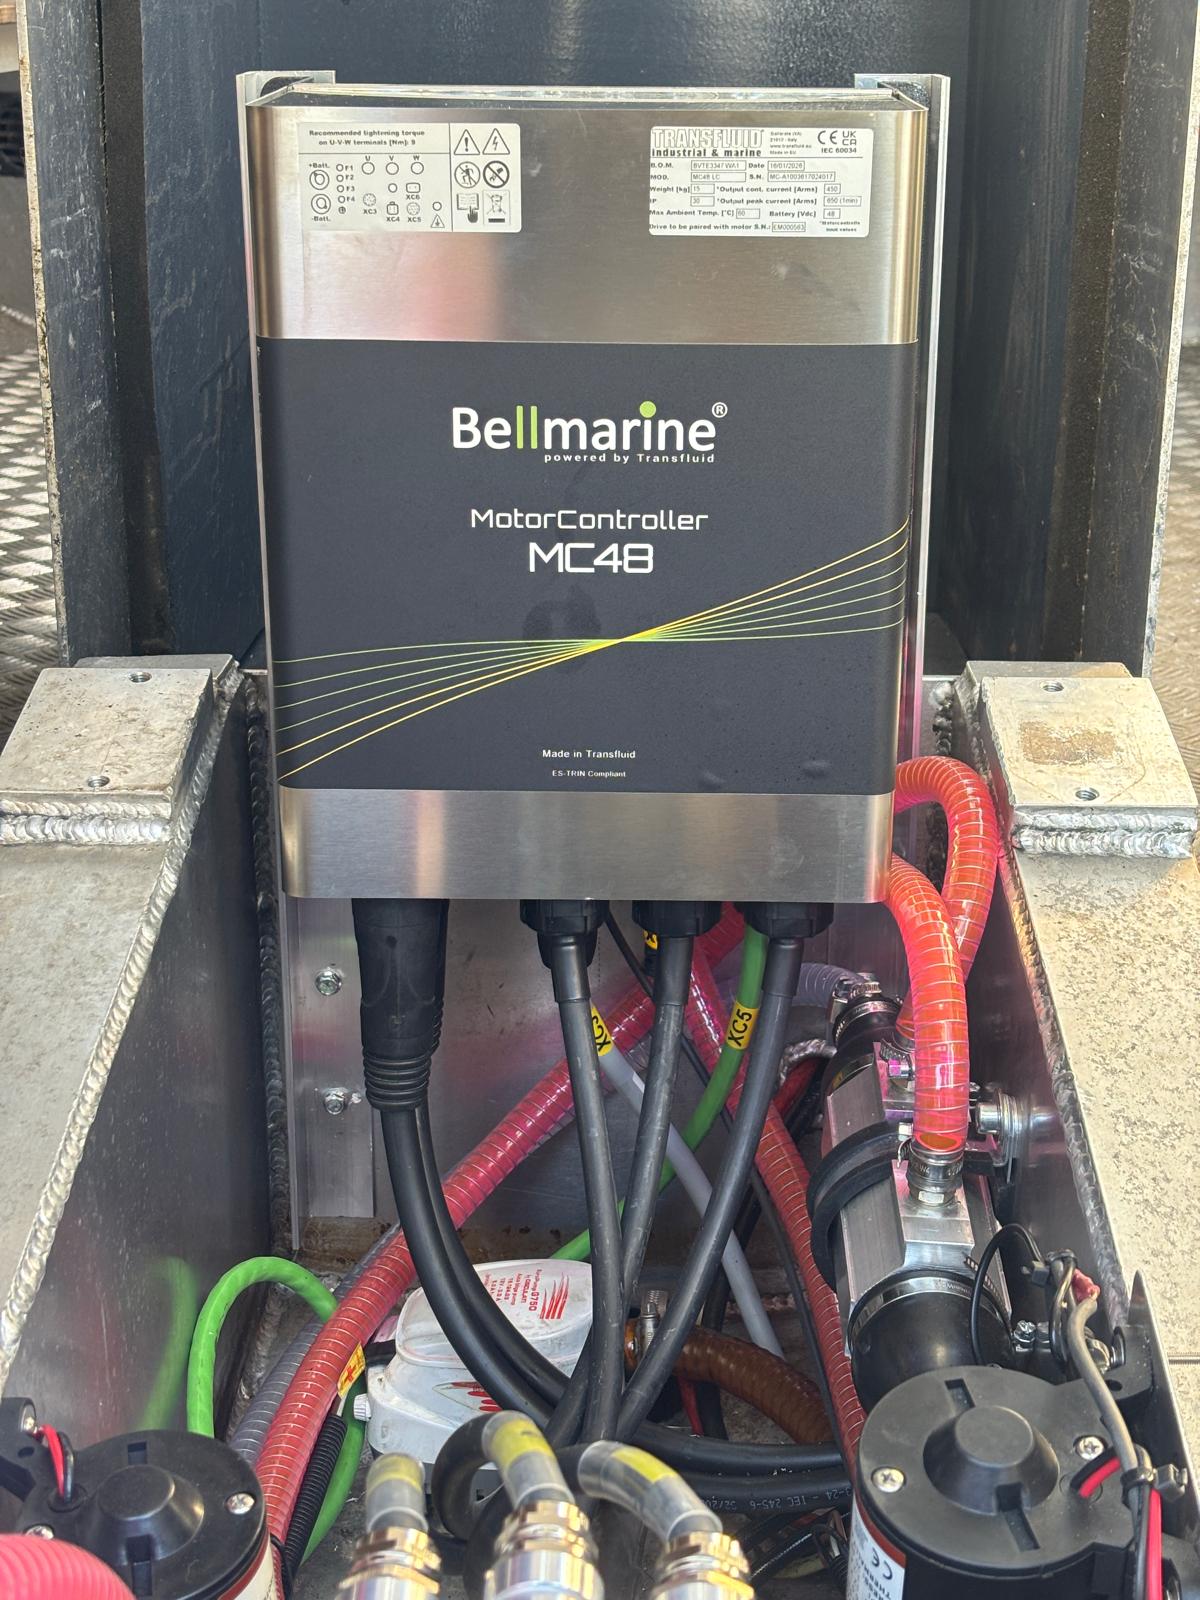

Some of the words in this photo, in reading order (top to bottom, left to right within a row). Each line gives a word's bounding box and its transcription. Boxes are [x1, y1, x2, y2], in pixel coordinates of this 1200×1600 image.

[652, 129, 762, 148] TRANSFLUID
[652, 148, 706, 157] industrial
[712, 149, 718, 157] &
[724, 149, 762, 157] marine
[544, 453, 606, 464] powered
[613, 453, 630, 464] by
[637, 453, 715, 464] Transfluid
[471, 508, 709, 530] MotorController
[528, 542, 654, 574] MC48
[542, 749, 570, 758] Made
[573, 749, 582, 758] in
[586, 749, 636, 759] Transfluid
[587, 770, 627, 778] Compliant
[728, 1009, 753, 1046] XC5
